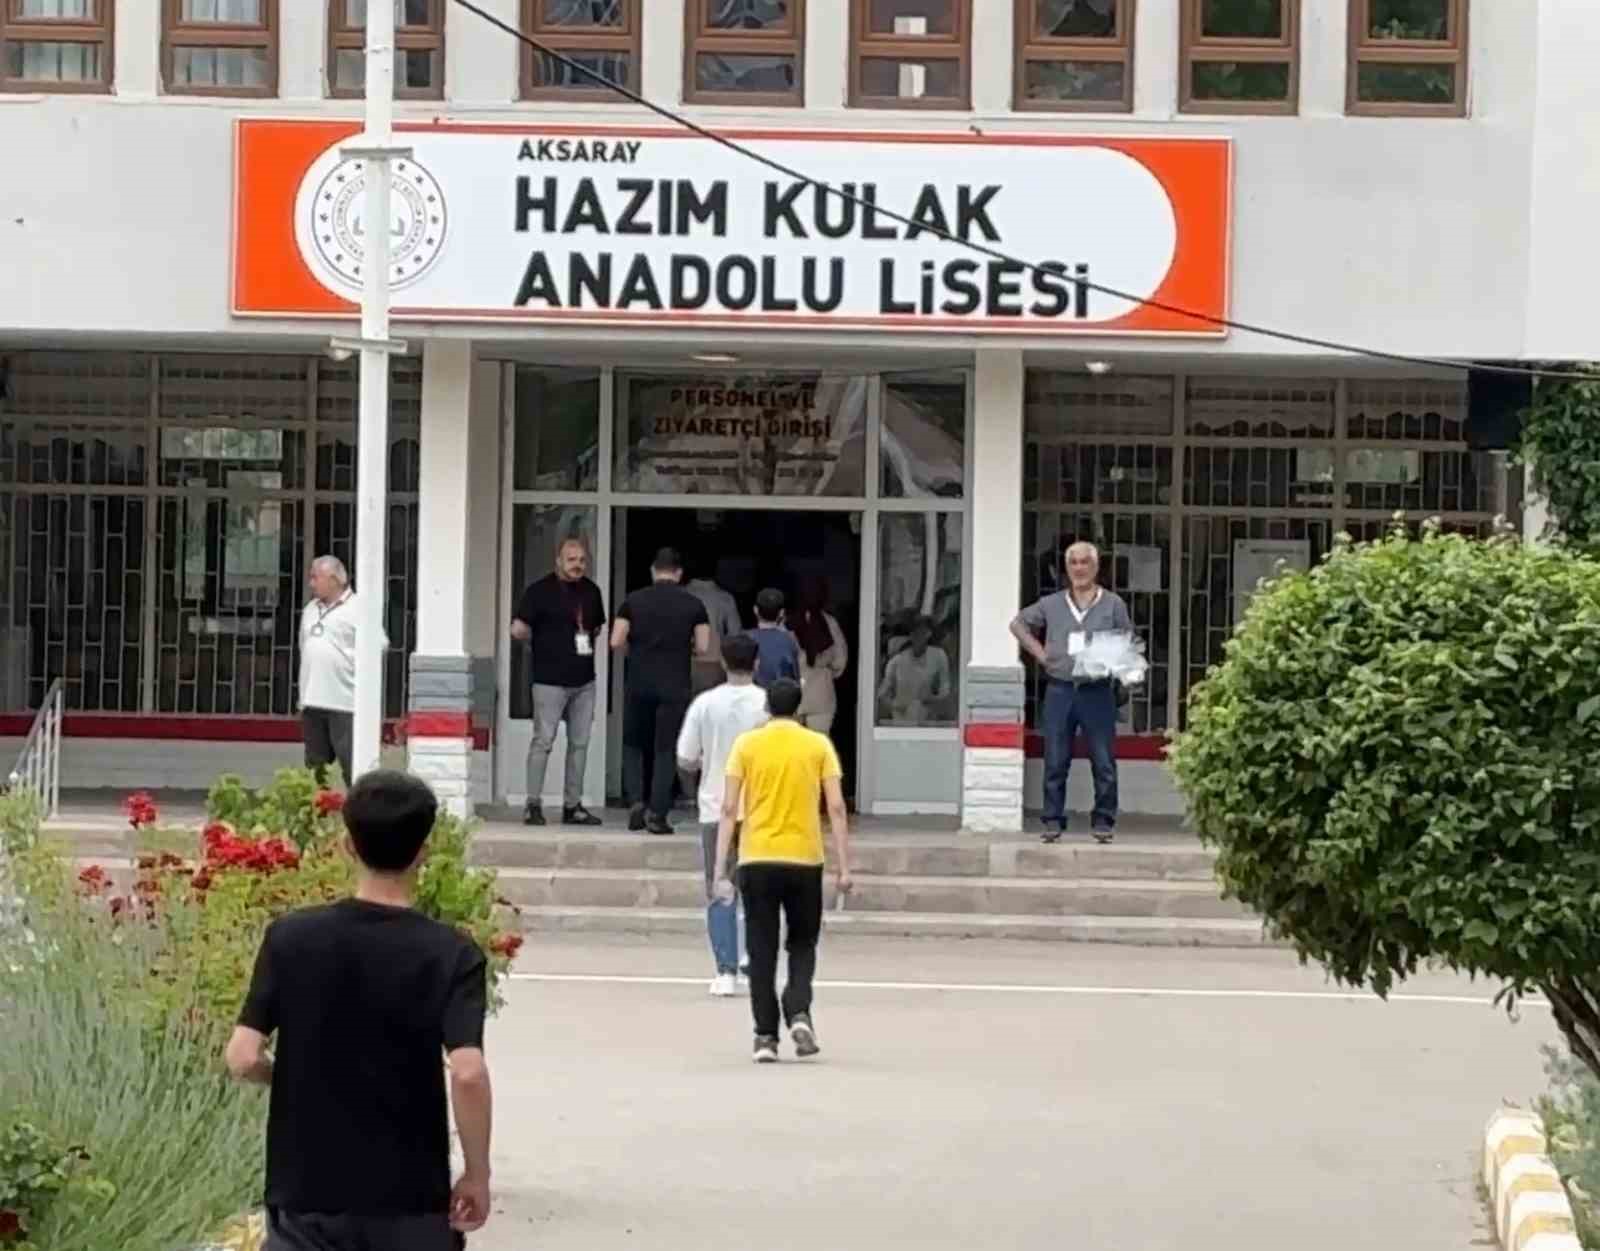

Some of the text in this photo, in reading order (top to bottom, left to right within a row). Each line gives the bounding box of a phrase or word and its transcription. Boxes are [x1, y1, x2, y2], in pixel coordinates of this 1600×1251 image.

[517, 139, 641, 163] AKSARAY
[515, 176, 1003, 242] HAZIM KULAK
[515, 251, 844, 313] ANADOLU
